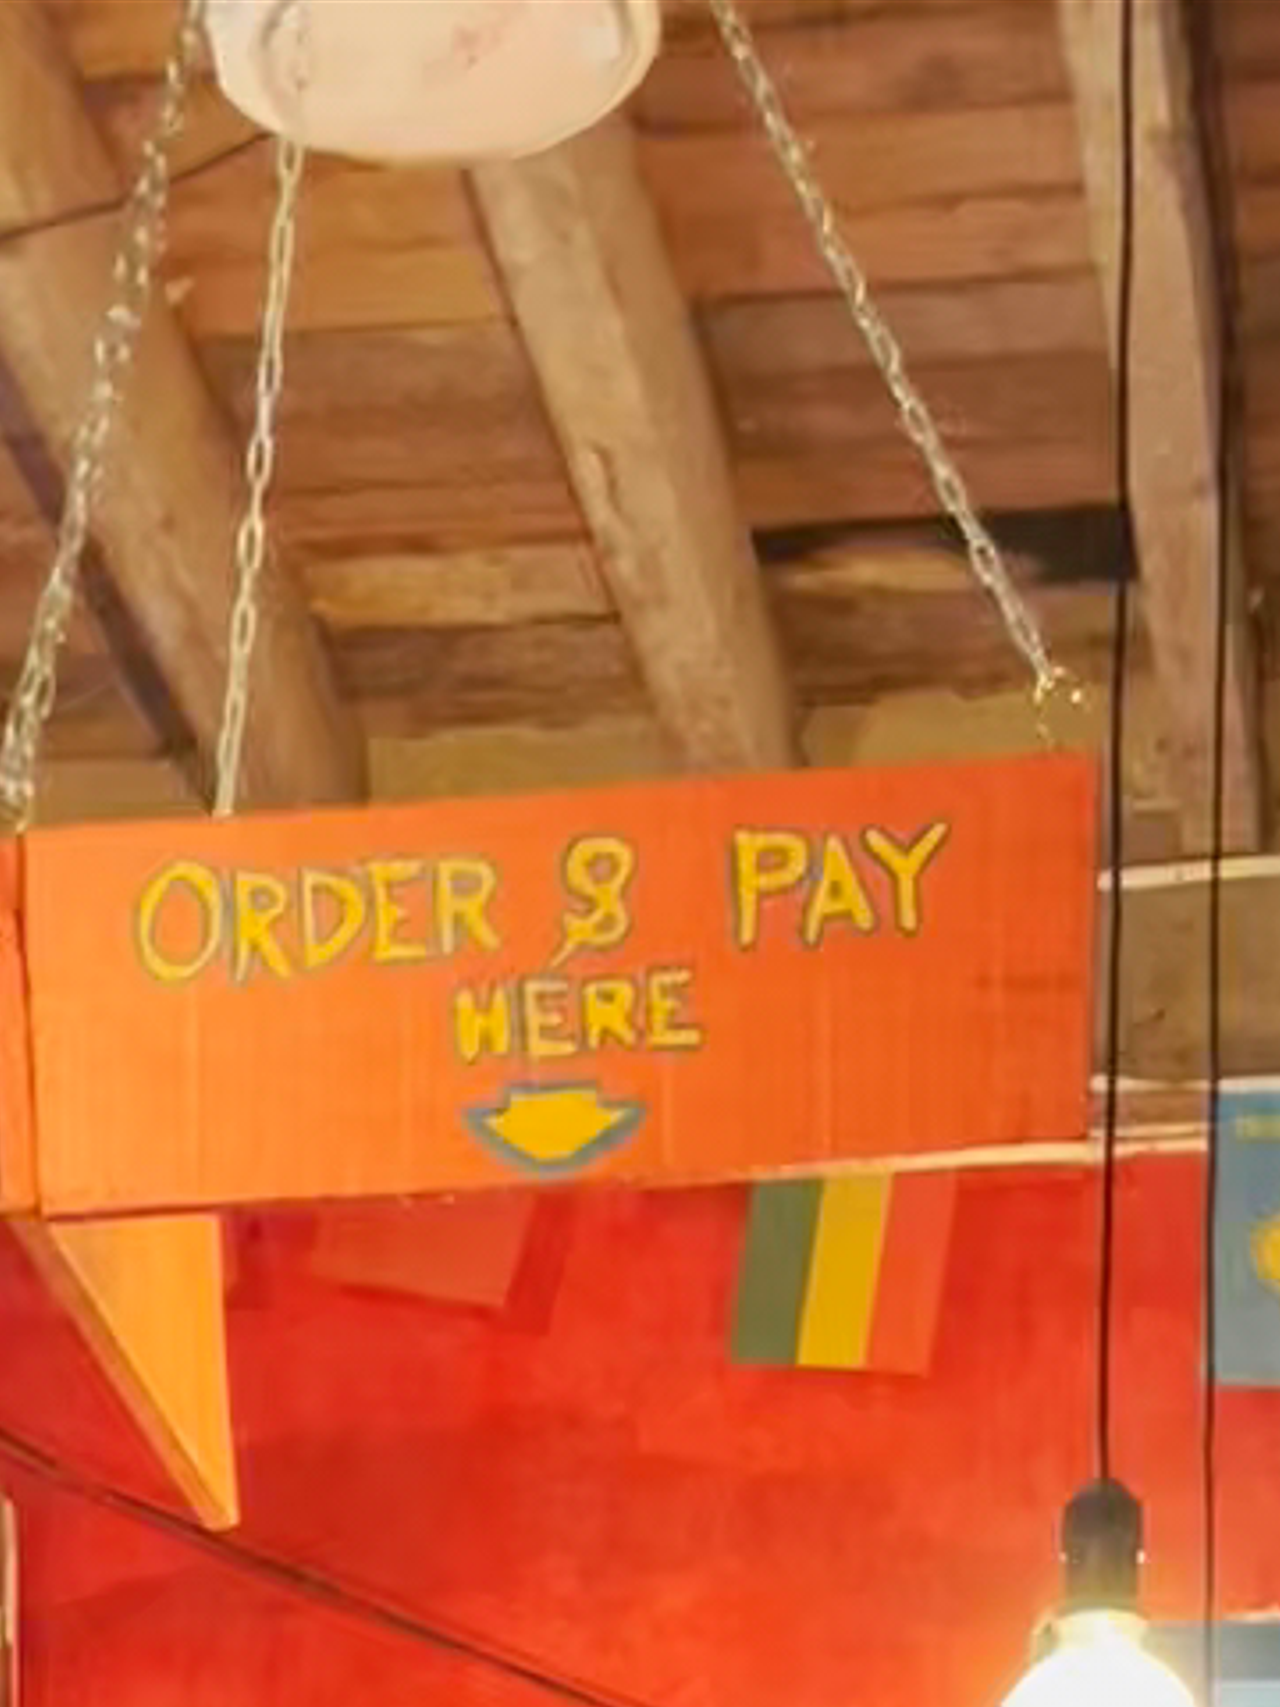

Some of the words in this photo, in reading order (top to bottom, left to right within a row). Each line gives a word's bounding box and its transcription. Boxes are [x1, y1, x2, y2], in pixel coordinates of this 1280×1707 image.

[136, 853, 501, 985] ORDER
[730, 820, 950, 952] PAY
[452, 968, 702, 1065] HERE
